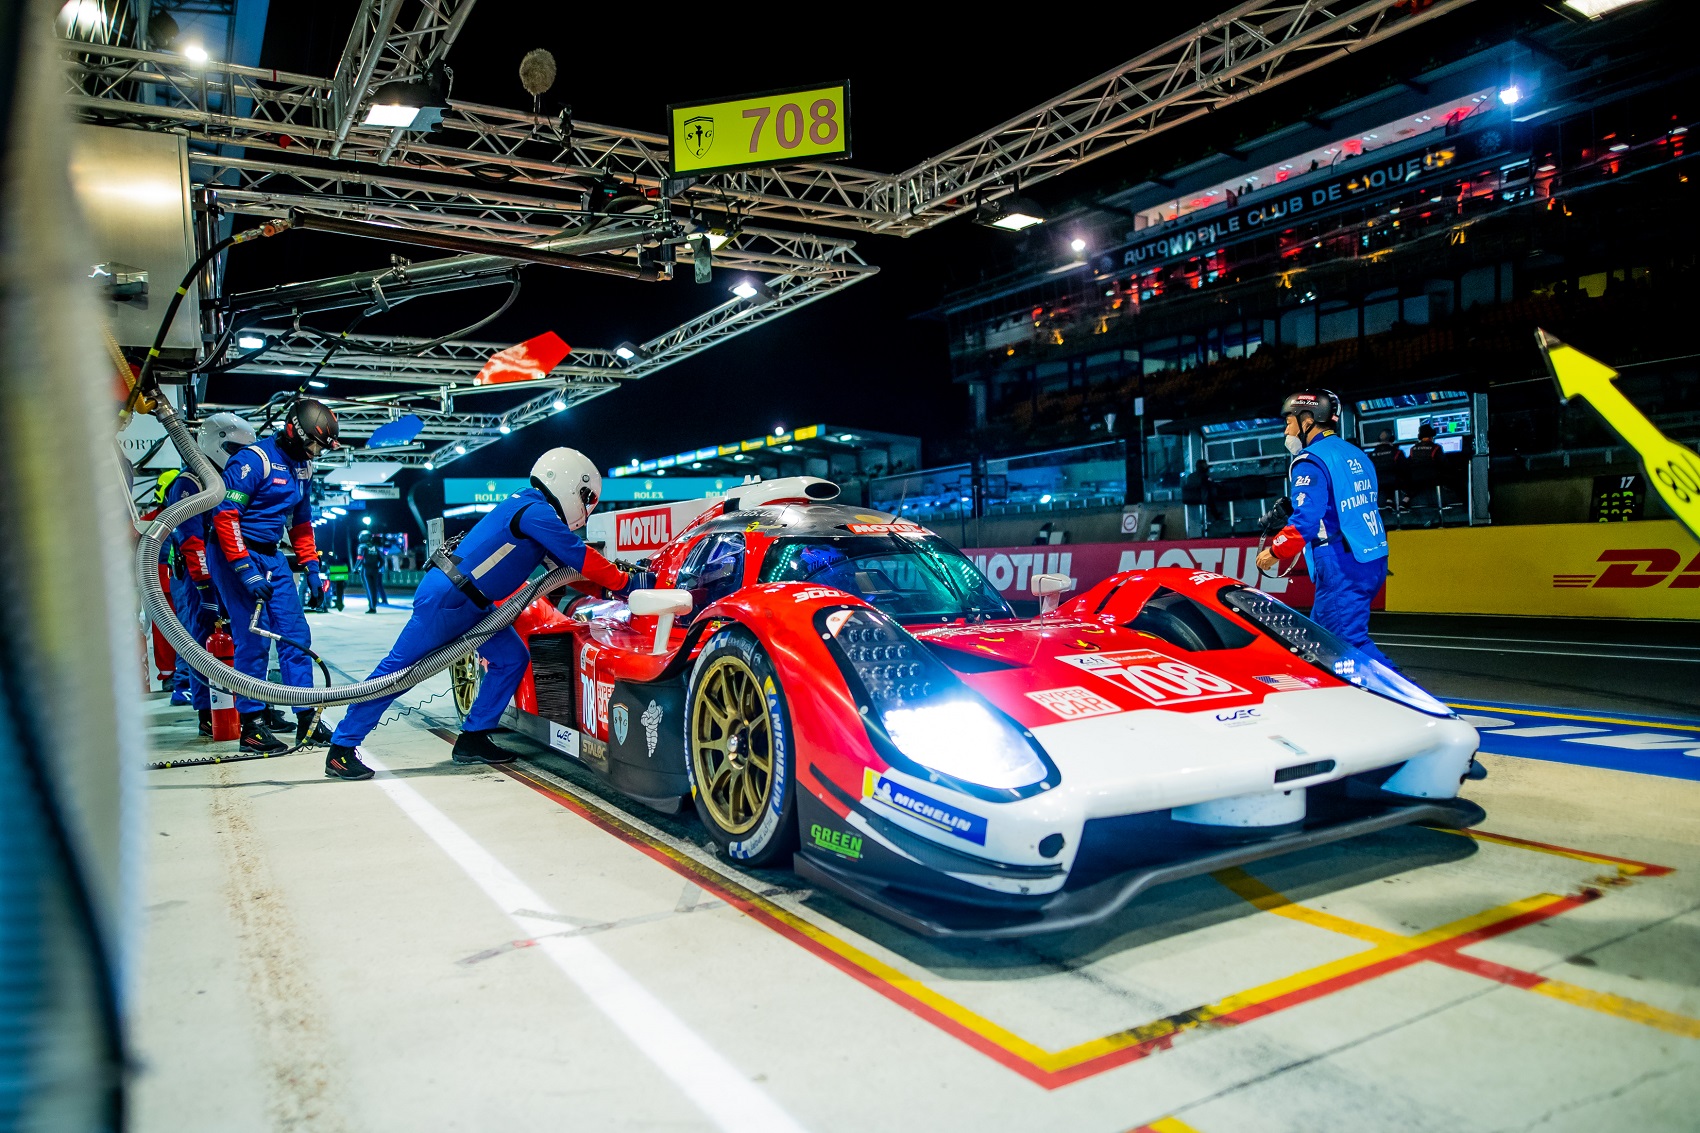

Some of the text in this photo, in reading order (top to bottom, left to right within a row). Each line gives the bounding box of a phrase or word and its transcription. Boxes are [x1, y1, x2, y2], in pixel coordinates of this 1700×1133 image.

[742, 98, 839, 153] 708
[1124, 216, 1240, 266] AUTOMOBILE
[1247, 198, 1304, 226] CLUB
[1311, 183, 1342, 205] DE
[291, 415, 310, 441] uvex
[1347, 458, 1362, 471] 24h
[634, 491, 664, 499] ROLEX
[1620, 475, 1636, 489] 17
[475, 493, 509, 502] ROLEX
[618, 514, 670, 546] MOTUL
[852, 524, 923, 533] MOTUL
[966, 553, 1077, 591] OTUL
[1092, 662, 1233, 700] 708
[581, 672, 597, 735] 708
[1034, 688, 1094, 704] HYPER
[1049, 696, 1112, 716] CAR
[1215, 708, 1261, 722] WEC
[556, 729, 571, 742] WEC
[771, 713, 785, 808] MICHELIN
[894, 792, 972, 832] MICHELIN
[811, 824, 863, 852] GREEN
